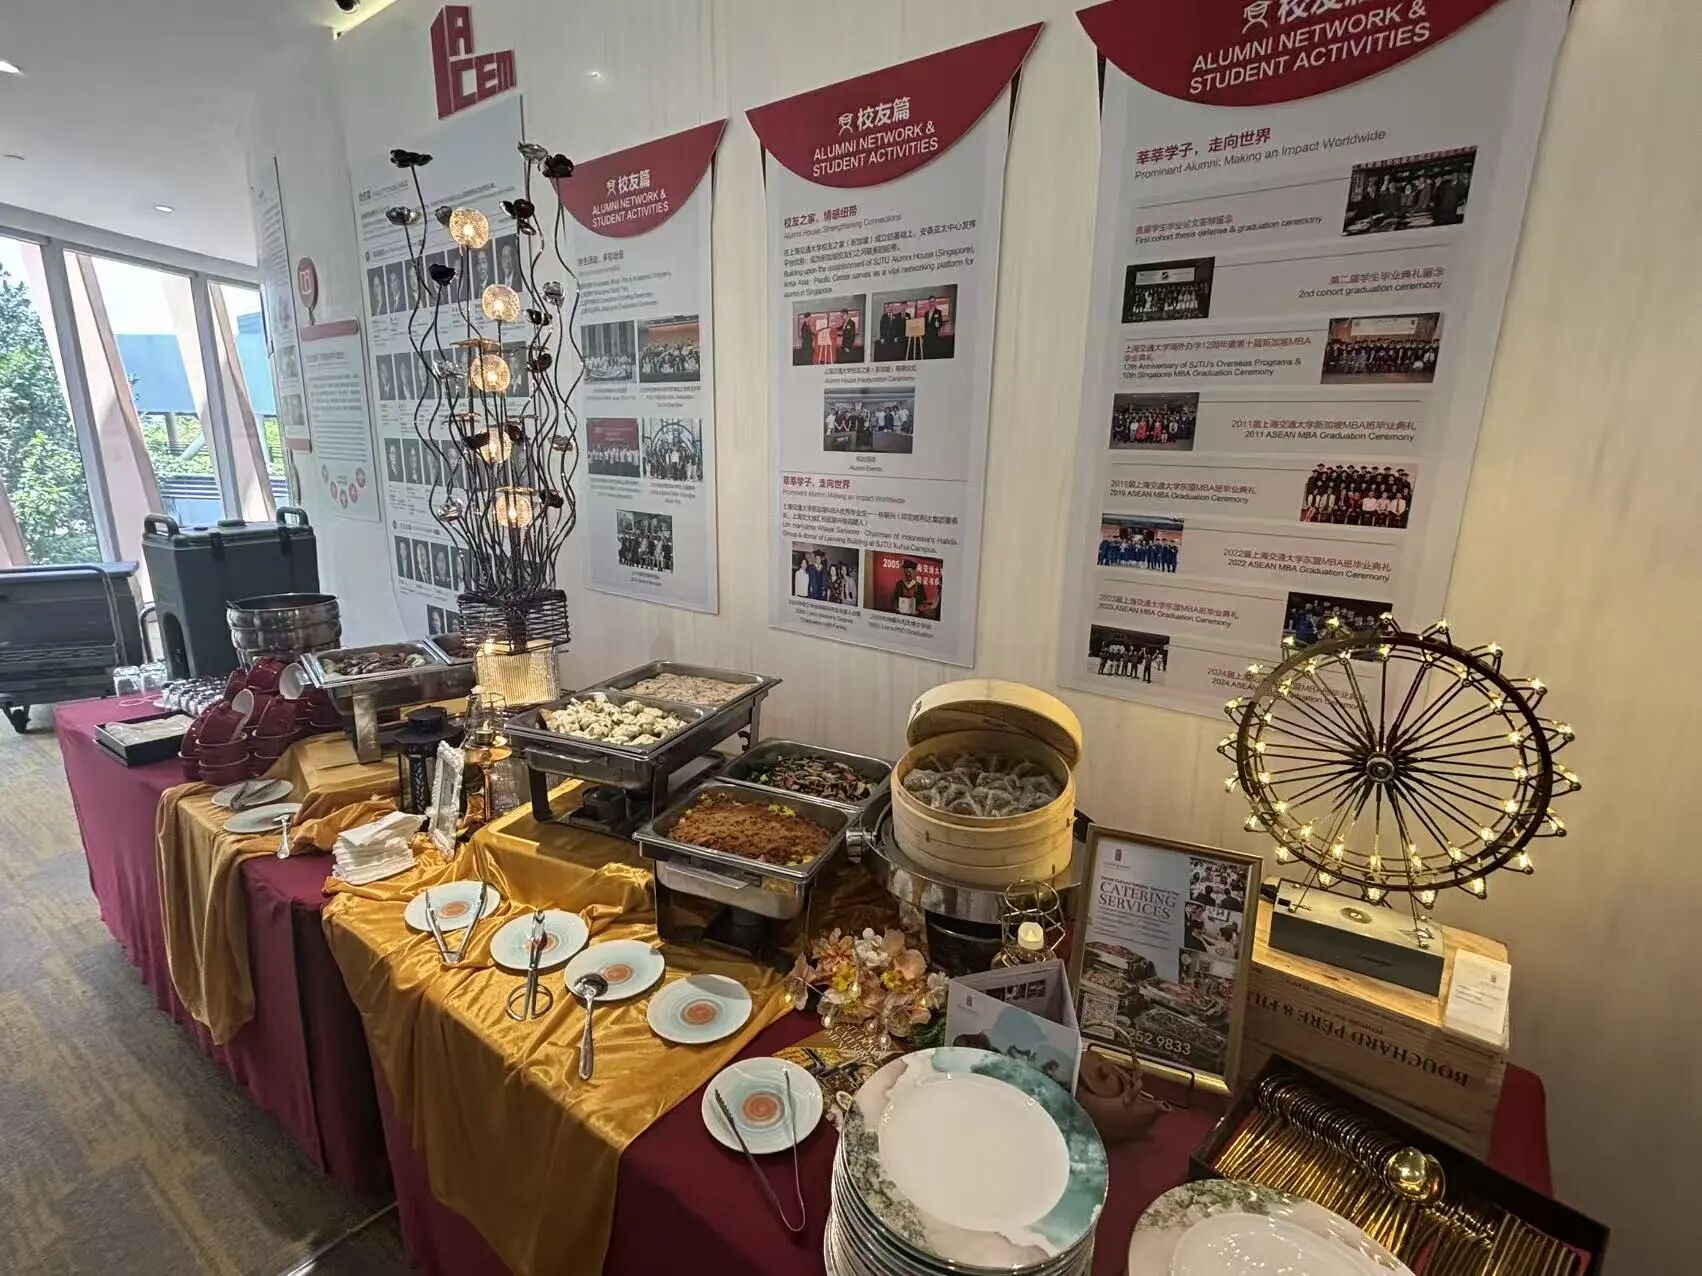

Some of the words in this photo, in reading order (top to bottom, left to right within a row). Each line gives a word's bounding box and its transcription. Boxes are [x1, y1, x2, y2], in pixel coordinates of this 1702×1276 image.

[1192, 37, 1273, 73] ALUMNI
[1279, 3, 1403, 51] NETWORK
[1408, 0, 1426, 19] &
[1190, 55, 1289, 96] STUDENT
[1293, 22, 1430, 72] ACTIVITIES
[857, 96, 911, 131] 校友篇
[814, 140, 857, 161] ALUMNI
[859, 125, 922, 150] NETWORK
[926, 121, 936, 133] &
[812, 154, 866, 177] STUDENT
[868, 137, 939, 164] ACTIVITIES
[1135, 165, 1182, 182] Prominent
[1224, 152, 1261, 168] Making
[1264, 149, 1278, 161] an
[1281, 141, 1319, 157] Impact
[1322, 128, 1386, 151] Worldwide
[617, 168, 651, 194] 校友篇
[592, 199, 620, 216] ALUMNI
[620, 190, 659, 209] NETWORK
[660, 188, 667, 200] &
[592, 211, 626, 228] STUDENT
[626, 200, 669, 220] ACTIVITIES
[1298, 289, 1315, 299] 2nd
[1316, 287, 1343, 298] cohort
[1345, 284, 1394, 297] graduation
[1394, 280, 1443, 293] ceremony
[1173, 370, 1192, 378] MBA
[1193, 369, 1233, 377] Graduation
[1234, 368, 1274, 379] Ceremony
[1180, 361, 1188, 369] of
[1216, 359, 1253, 368] Overseas
[1254, 358, 1293, 369] Programs
[1244, 430, 1264, 439] 2011
[1265, 430, 1296, 440] ASEAN
[1297, 431, 1318, 440] MBA
[1319, 431, 1366, 441] Graduation
[1368, 432, 1415, 444] Ceremony
[1110, 489, 1126, 498] 2019
[1127, 490, 1152, 499] ASEAN
[1171, 492, 1210, 501] Graduation
[1211, 494, 1249, 505] Ceremony
[1228, 558, 1247, 568] 2022
[1248, 560, 1278, 571] ASEAN
[1278, 563, 1298, 573] MBA
[1299, 565, 1344, 577] Graduation
[1345, 569, 1390, 583] Ceremony
[1115, 604, 1139, 614] ASEAN
[1140, 607, 1156, 616] MBA
[1157, 609, 1194, 622] Graduation
[1195, 614, 1233, 629] Ceremony
[1212, 677, 1229, 687] 2024
[1098, 893, 1171, 920] SERVICES
[1100, 881, 1177, 908] CATERING
[1156, 1035, 1192, 1056] 9833
[1351, 1029, 1470, 1088] BOUCHARD
